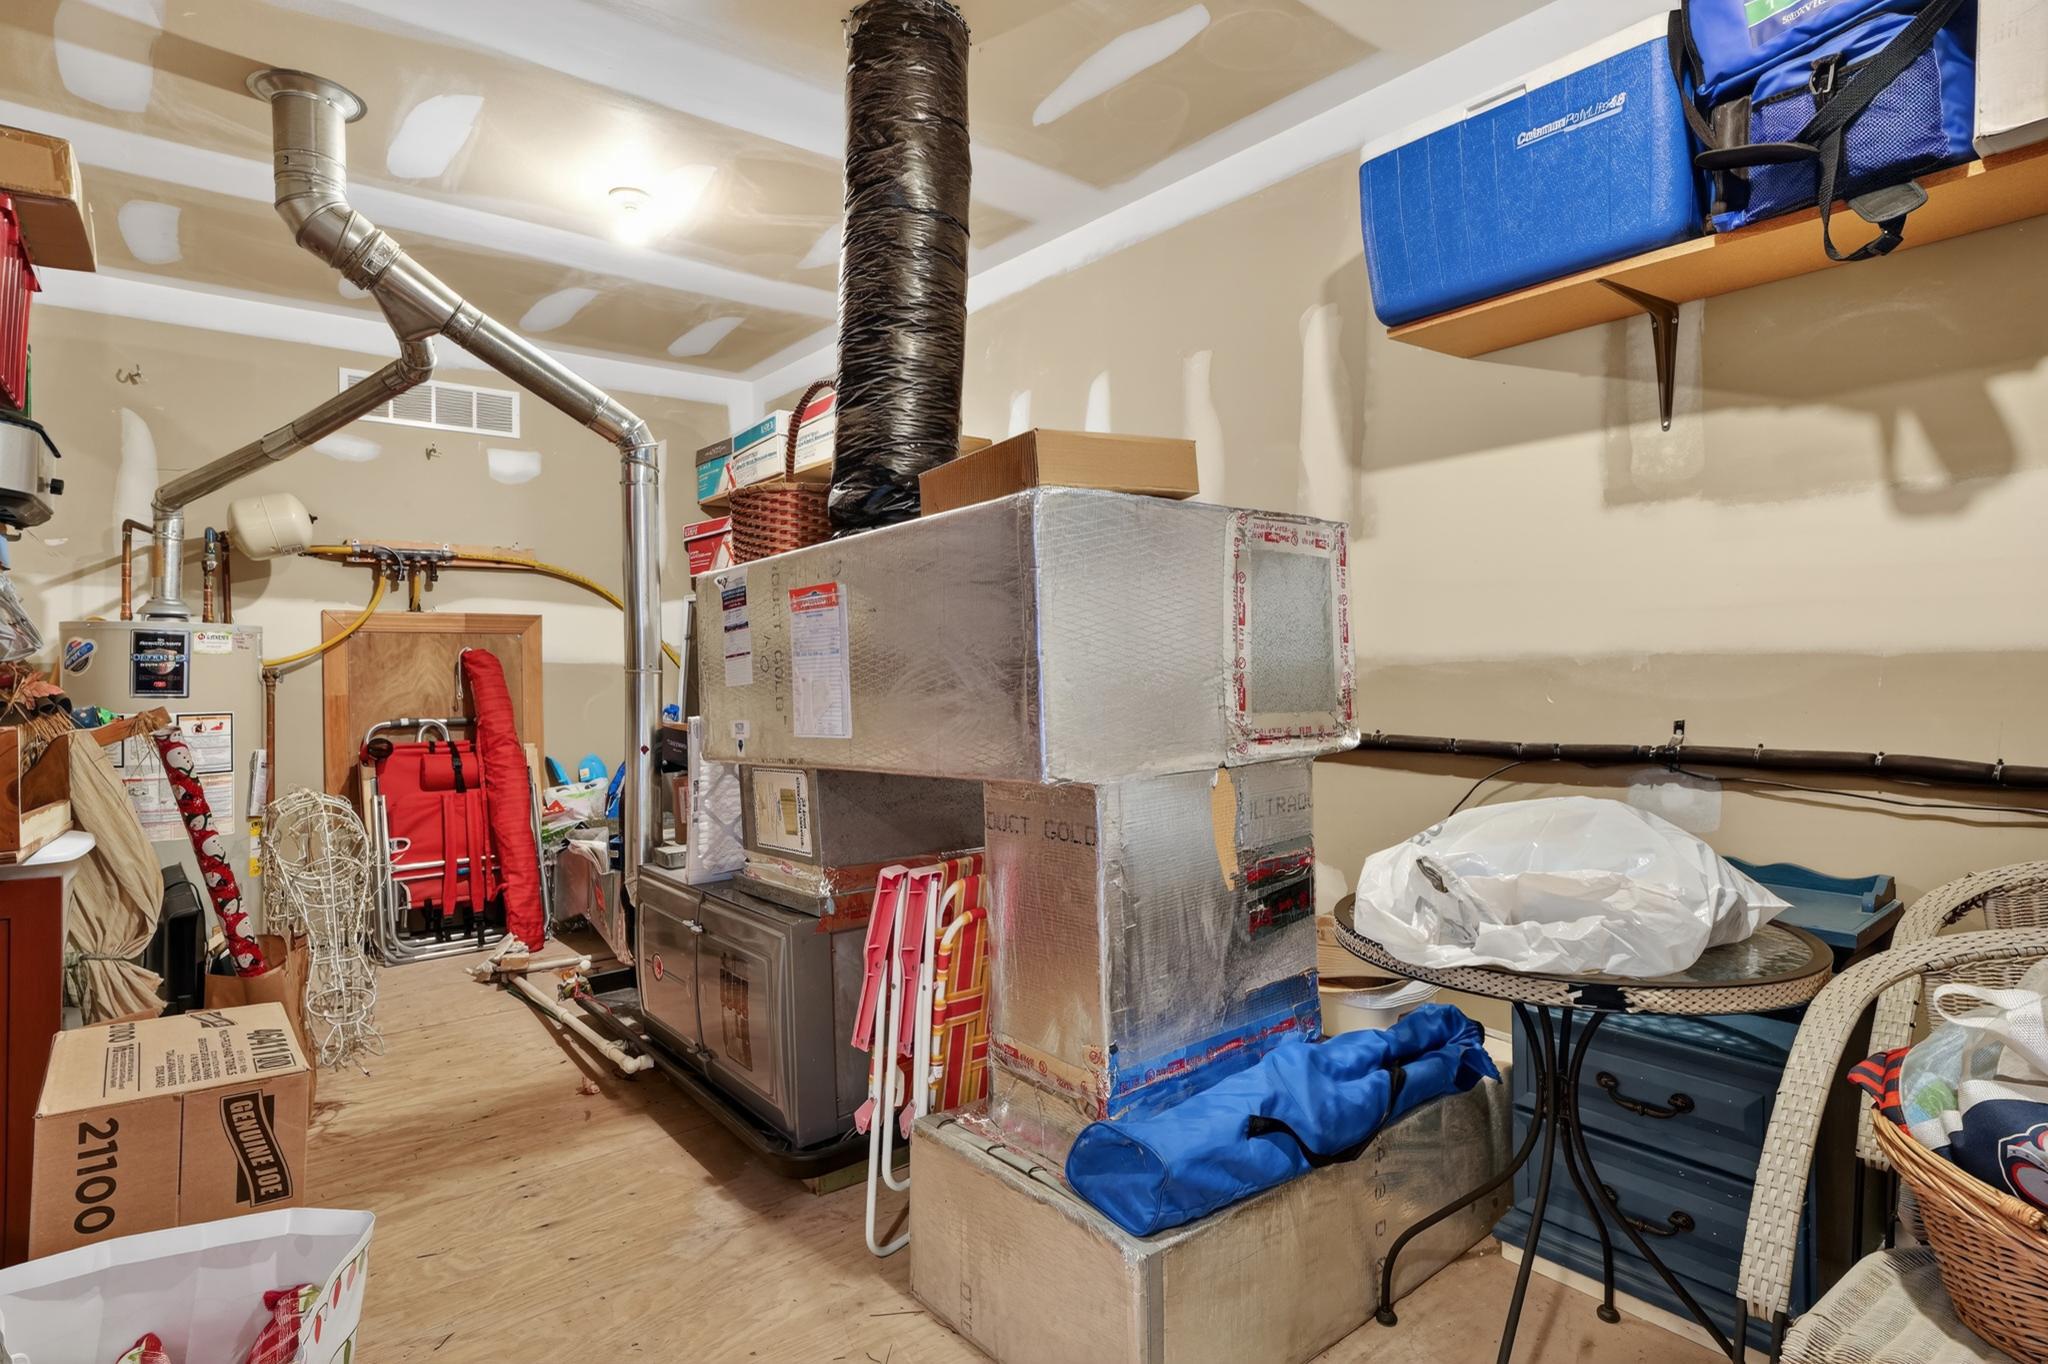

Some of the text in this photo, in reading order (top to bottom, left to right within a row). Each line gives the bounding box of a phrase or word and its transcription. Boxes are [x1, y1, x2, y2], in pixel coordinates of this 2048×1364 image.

[986, 812, 1096, 847] DUCT GOLD
[74, 1118, 118, 1234] 21100
[230, 1100, 283, 1196] GENUINE JOE
